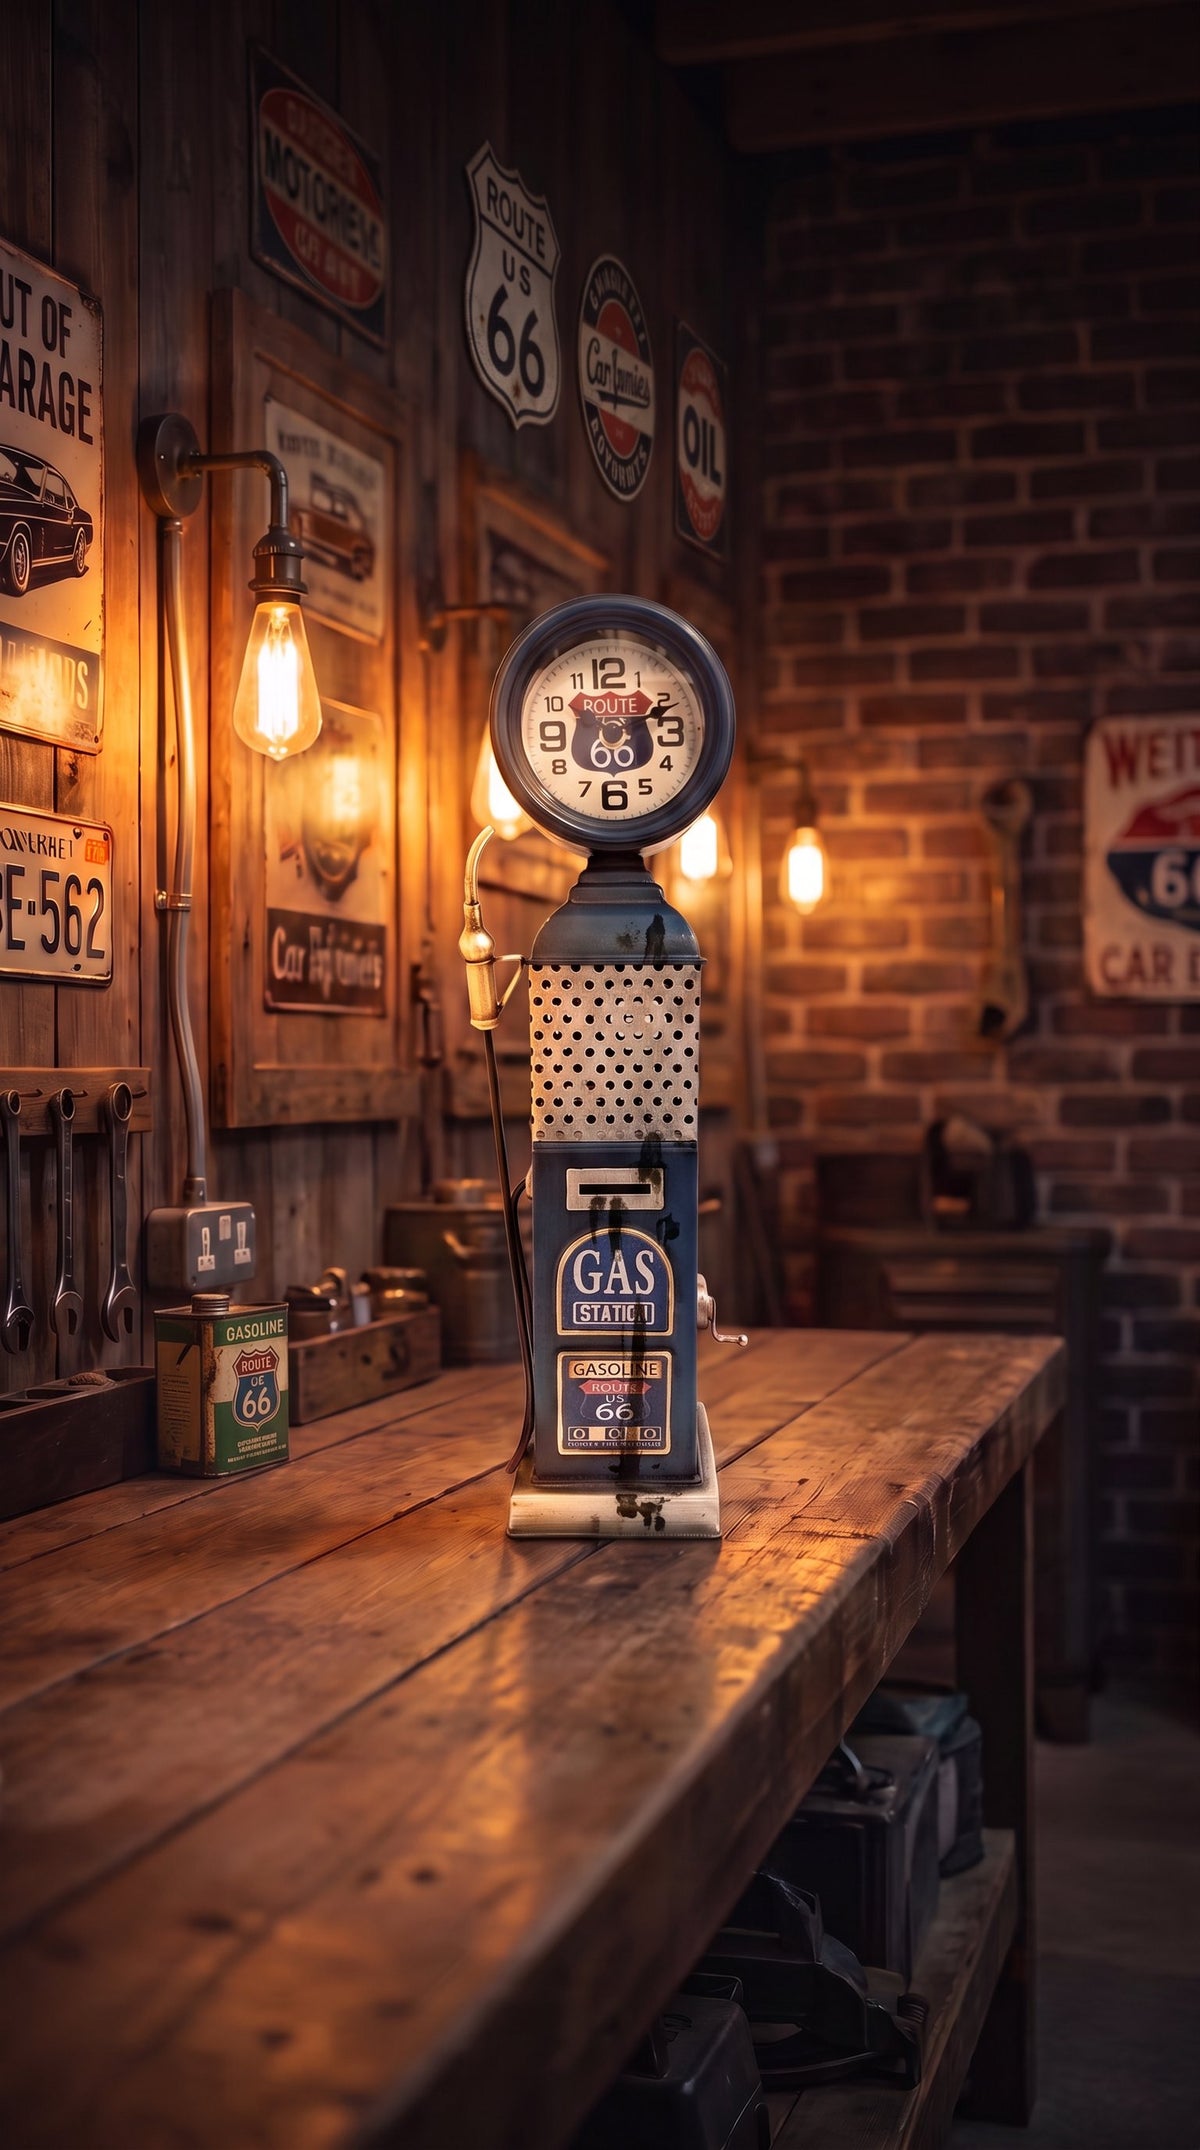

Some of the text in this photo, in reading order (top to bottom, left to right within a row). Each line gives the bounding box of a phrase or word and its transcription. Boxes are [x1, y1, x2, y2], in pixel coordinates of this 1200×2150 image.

[486, 176, 546, 260] ROUTE
[502, 250, 531, 297] US
[41, 294, 73, 360] OF
[487, 284, 545, 398] 66
[0, 338, 94, 446] ARAGE
[684, 403, 721, 487] OIL
[570, 672, 584, 690] 11
[592, 657, 626, 689] 12
[634, 671, 641, 688] 1
[544, 696, 564, 713] 10
[583, 698, 638, 714] ROUTE
[539, 721, 567, 753] 9
[657, 716, 684, 747] 3
[552, 759, 568, 775] 8
[659, 755, 673, 772] 4
[578, 781, 592, 798] 7
[601, 780, 629, 811] 6
[638, 778, 653, 796] 5
[1152, 852, 1200, 909] 6
[0, 863, 105, 960] E-562
[1101, 943, 1174, 987] CAR
[573, 1249, 655, 1295] GAS
[226, 1318, 284, 1342] GASOLINE
[241, 1355, 272, 1373] ROUTE
[573, 1363, 658, 1376] GASOLINE
[242, 1387, 271, 1419] 66
[595, 1403, 634, 1421] 66
[605, 1394, 625, 1403] US
